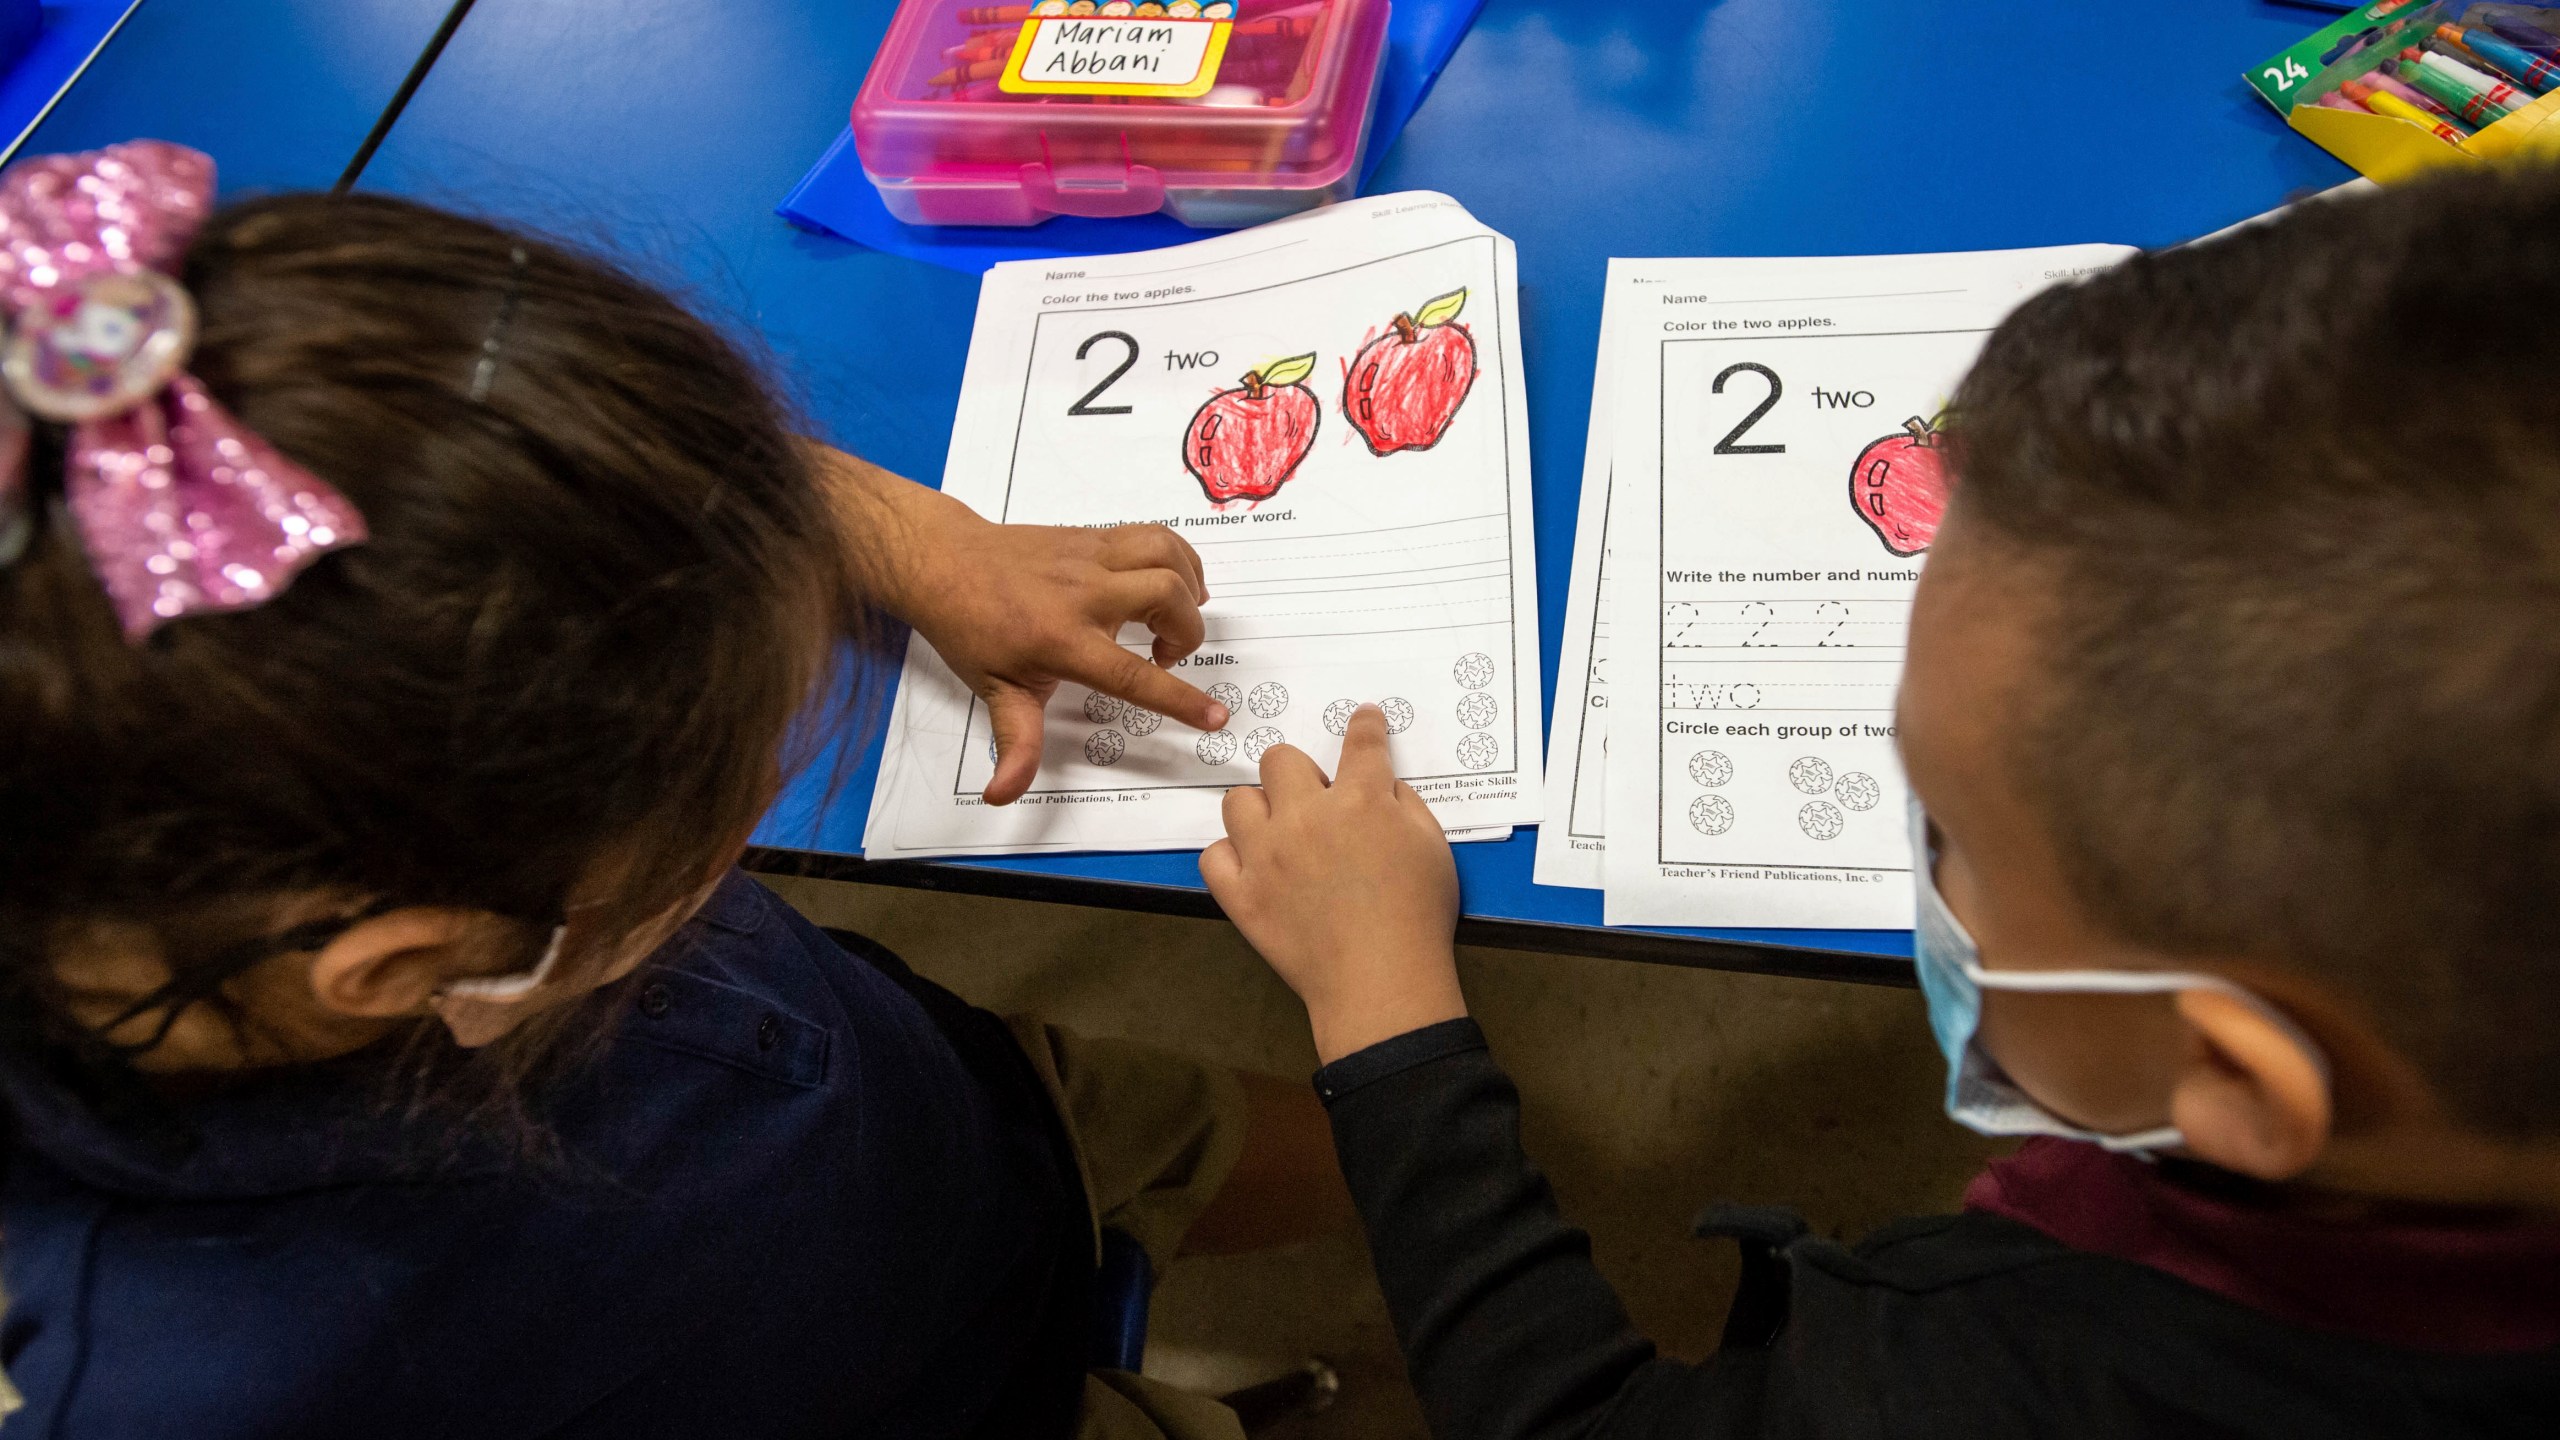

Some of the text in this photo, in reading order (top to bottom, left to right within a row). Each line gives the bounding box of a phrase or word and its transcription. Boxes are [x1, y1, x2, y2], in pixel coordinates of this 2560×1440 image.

[1055, 21, 1174, 45] Mariam
[1046, 49, 1167, 75] Abbani
[2263, 55, 2309, 92] 24
[1396, 202, 1437, 214] Learning
[1046, 271, 1086, 280] Name
[1042, 285, 1196, 305] Color the two apples.
[1663, 294, 1708, 304] Name
[1663, 316, 1837, 331] Color the two apples.
[1067, 330, 1219, 416] 2 two
[1712, 362, 1875, 454] 2 two
[1185, 515, 1247, 526] number
[1253, 510, 1297, 523] word.
[1667, 569, 1920, 583] Write the number and numb
[1667, 601, 1854, 648] 2 2 2
[1194, 653, 1239, 666] balls.
[1666, 721, 1719, 735] Circle
[1725, 723, 1770, 736] each
[1776, 726, 1832, 740] group
[1839, 724, 1858, 736] of
[1455, 778, 1485, 789] Basic
[1488, 776, 1517, 787] Skills
[1046, 794, 1114, 804] Publications,
[1118, 794, 1137, 802] Inc.
[1421, 790, 1518, 804] umbers, Counting
[1720, 869, 1760, 879] Friend
[1764, 870, 1842, 881] Publications,
[1846, 873, 1869, 882] Inc.
